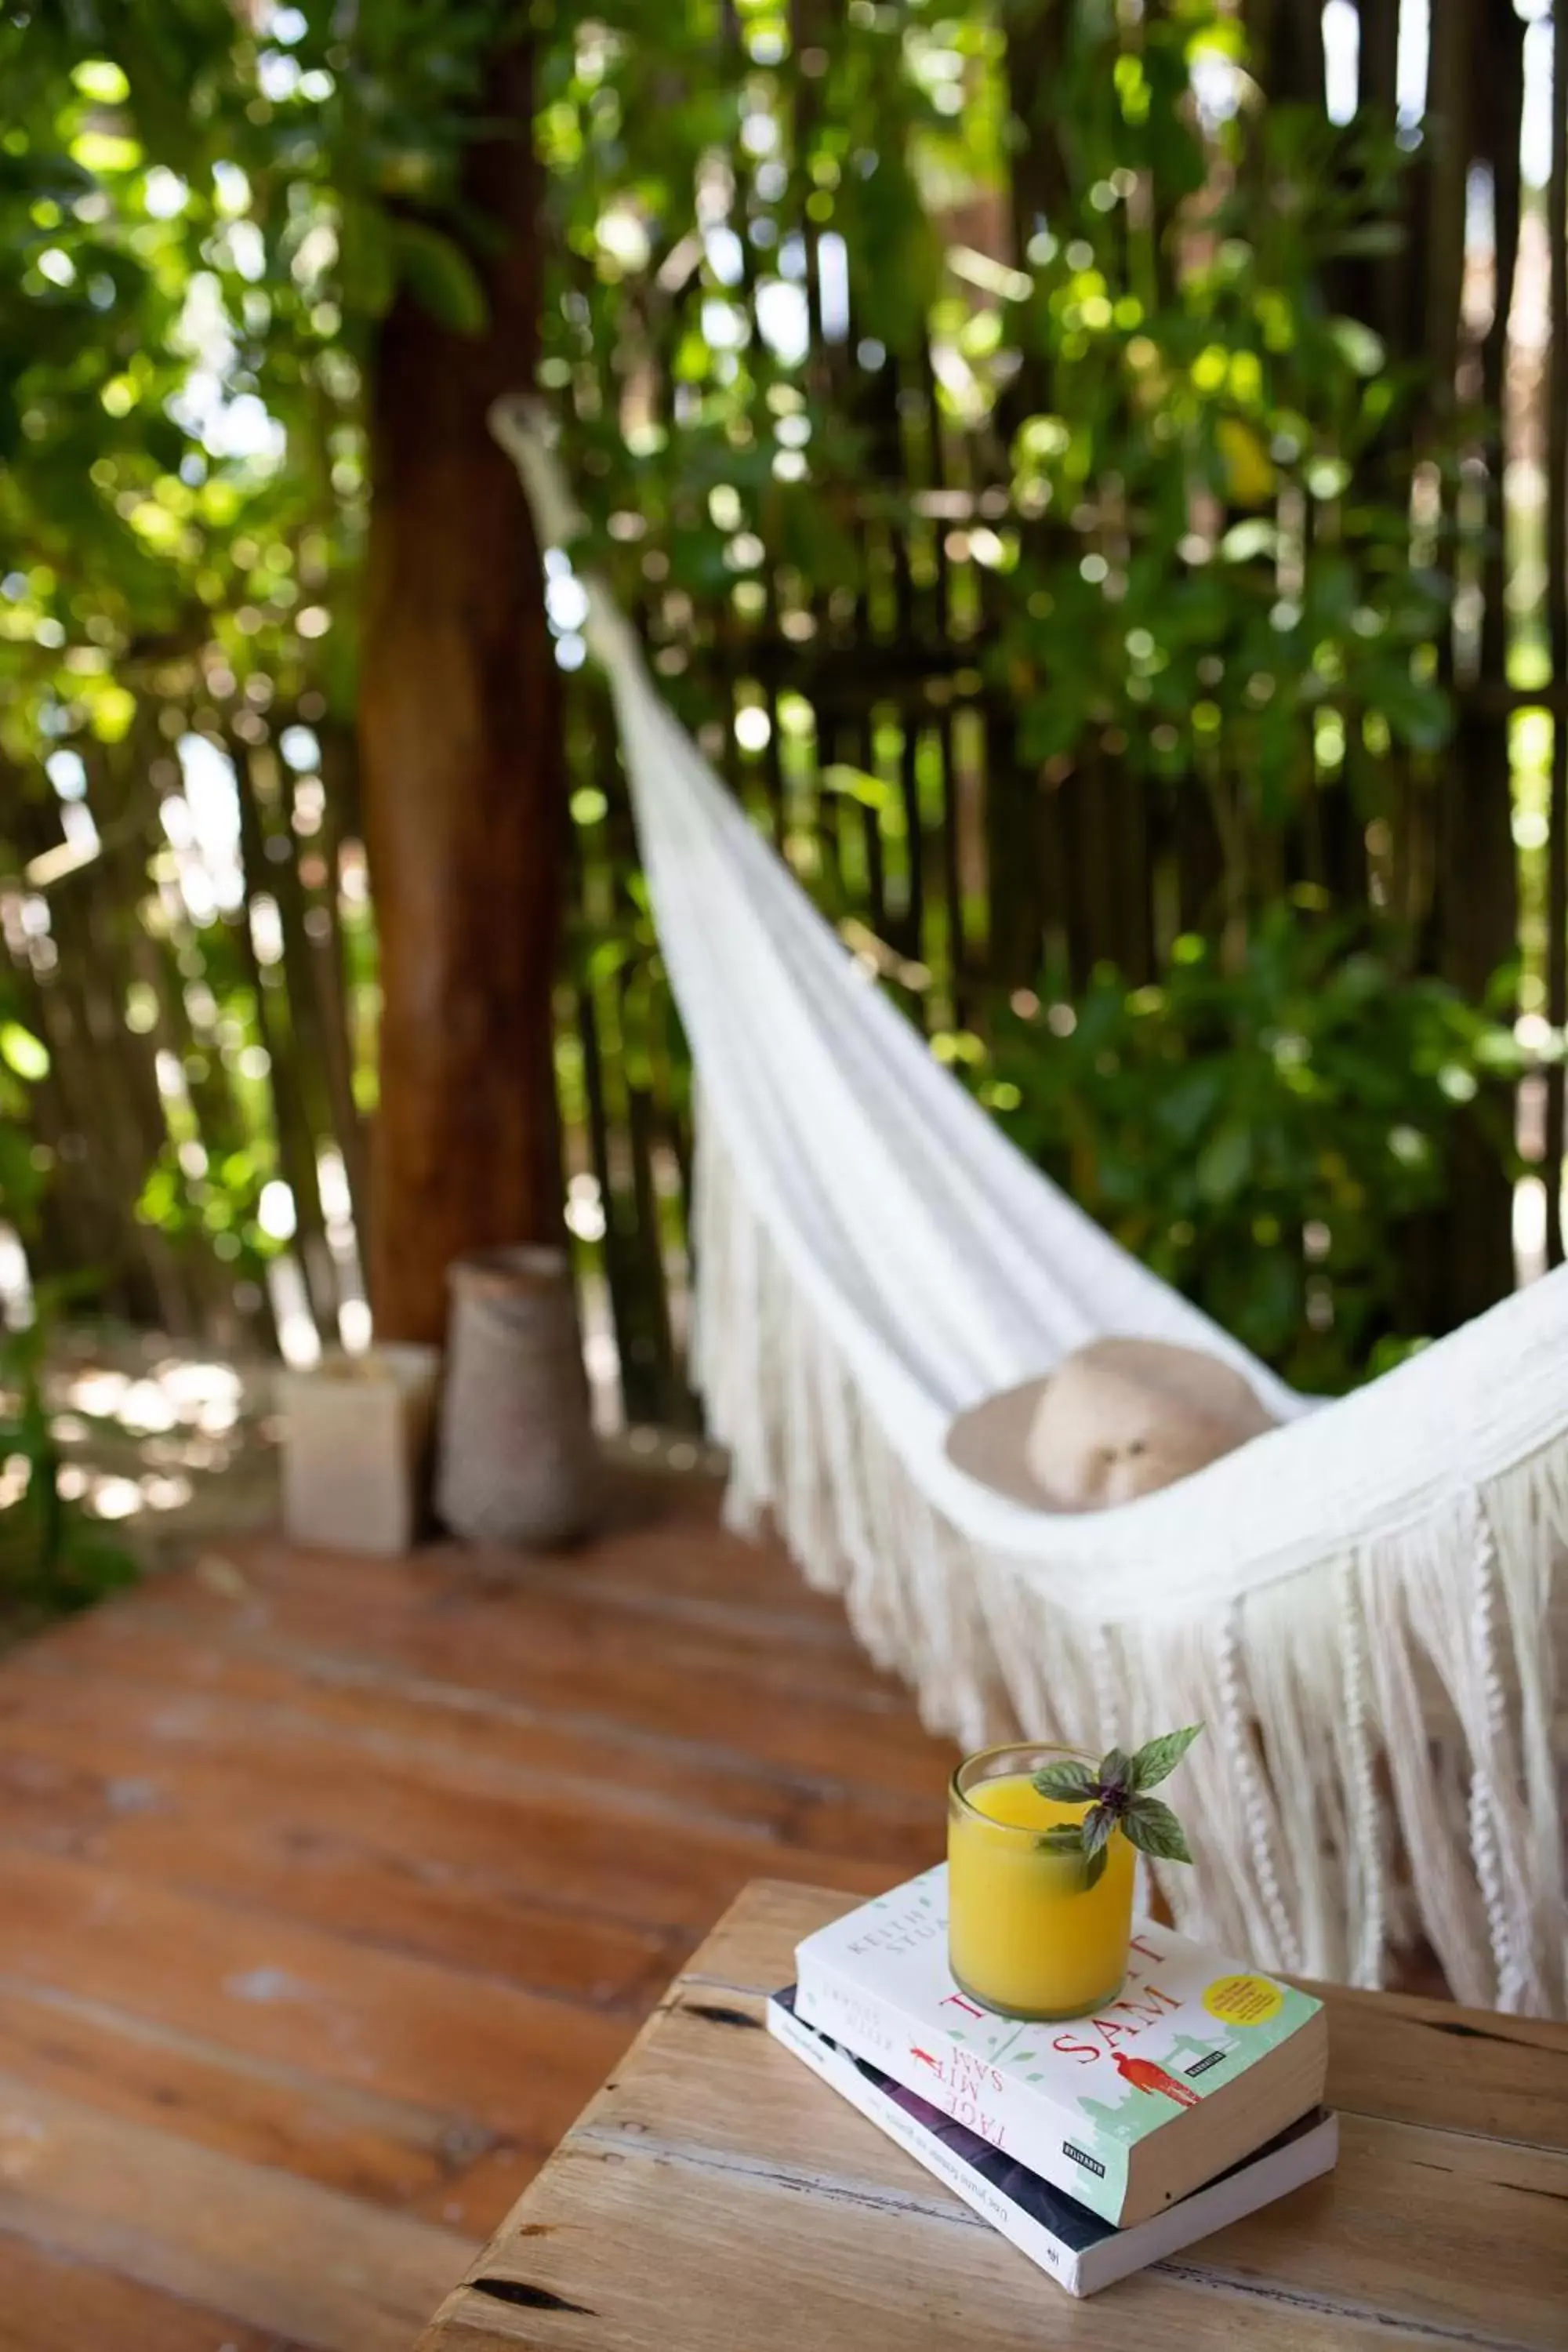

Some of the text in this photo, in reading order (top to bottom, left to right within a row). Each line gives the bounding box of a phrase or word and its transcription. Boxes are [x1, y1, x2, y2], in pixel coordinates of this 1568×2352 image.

[847, 1910, 927, 1955] KEITH
[1053, 1985, 1185, 2064] SAM
[933, 2061, 978, 2102] MIT
[953, 2046, 1004, 2092] SAM
[944, 2090, 1006, 2149] TAGE
